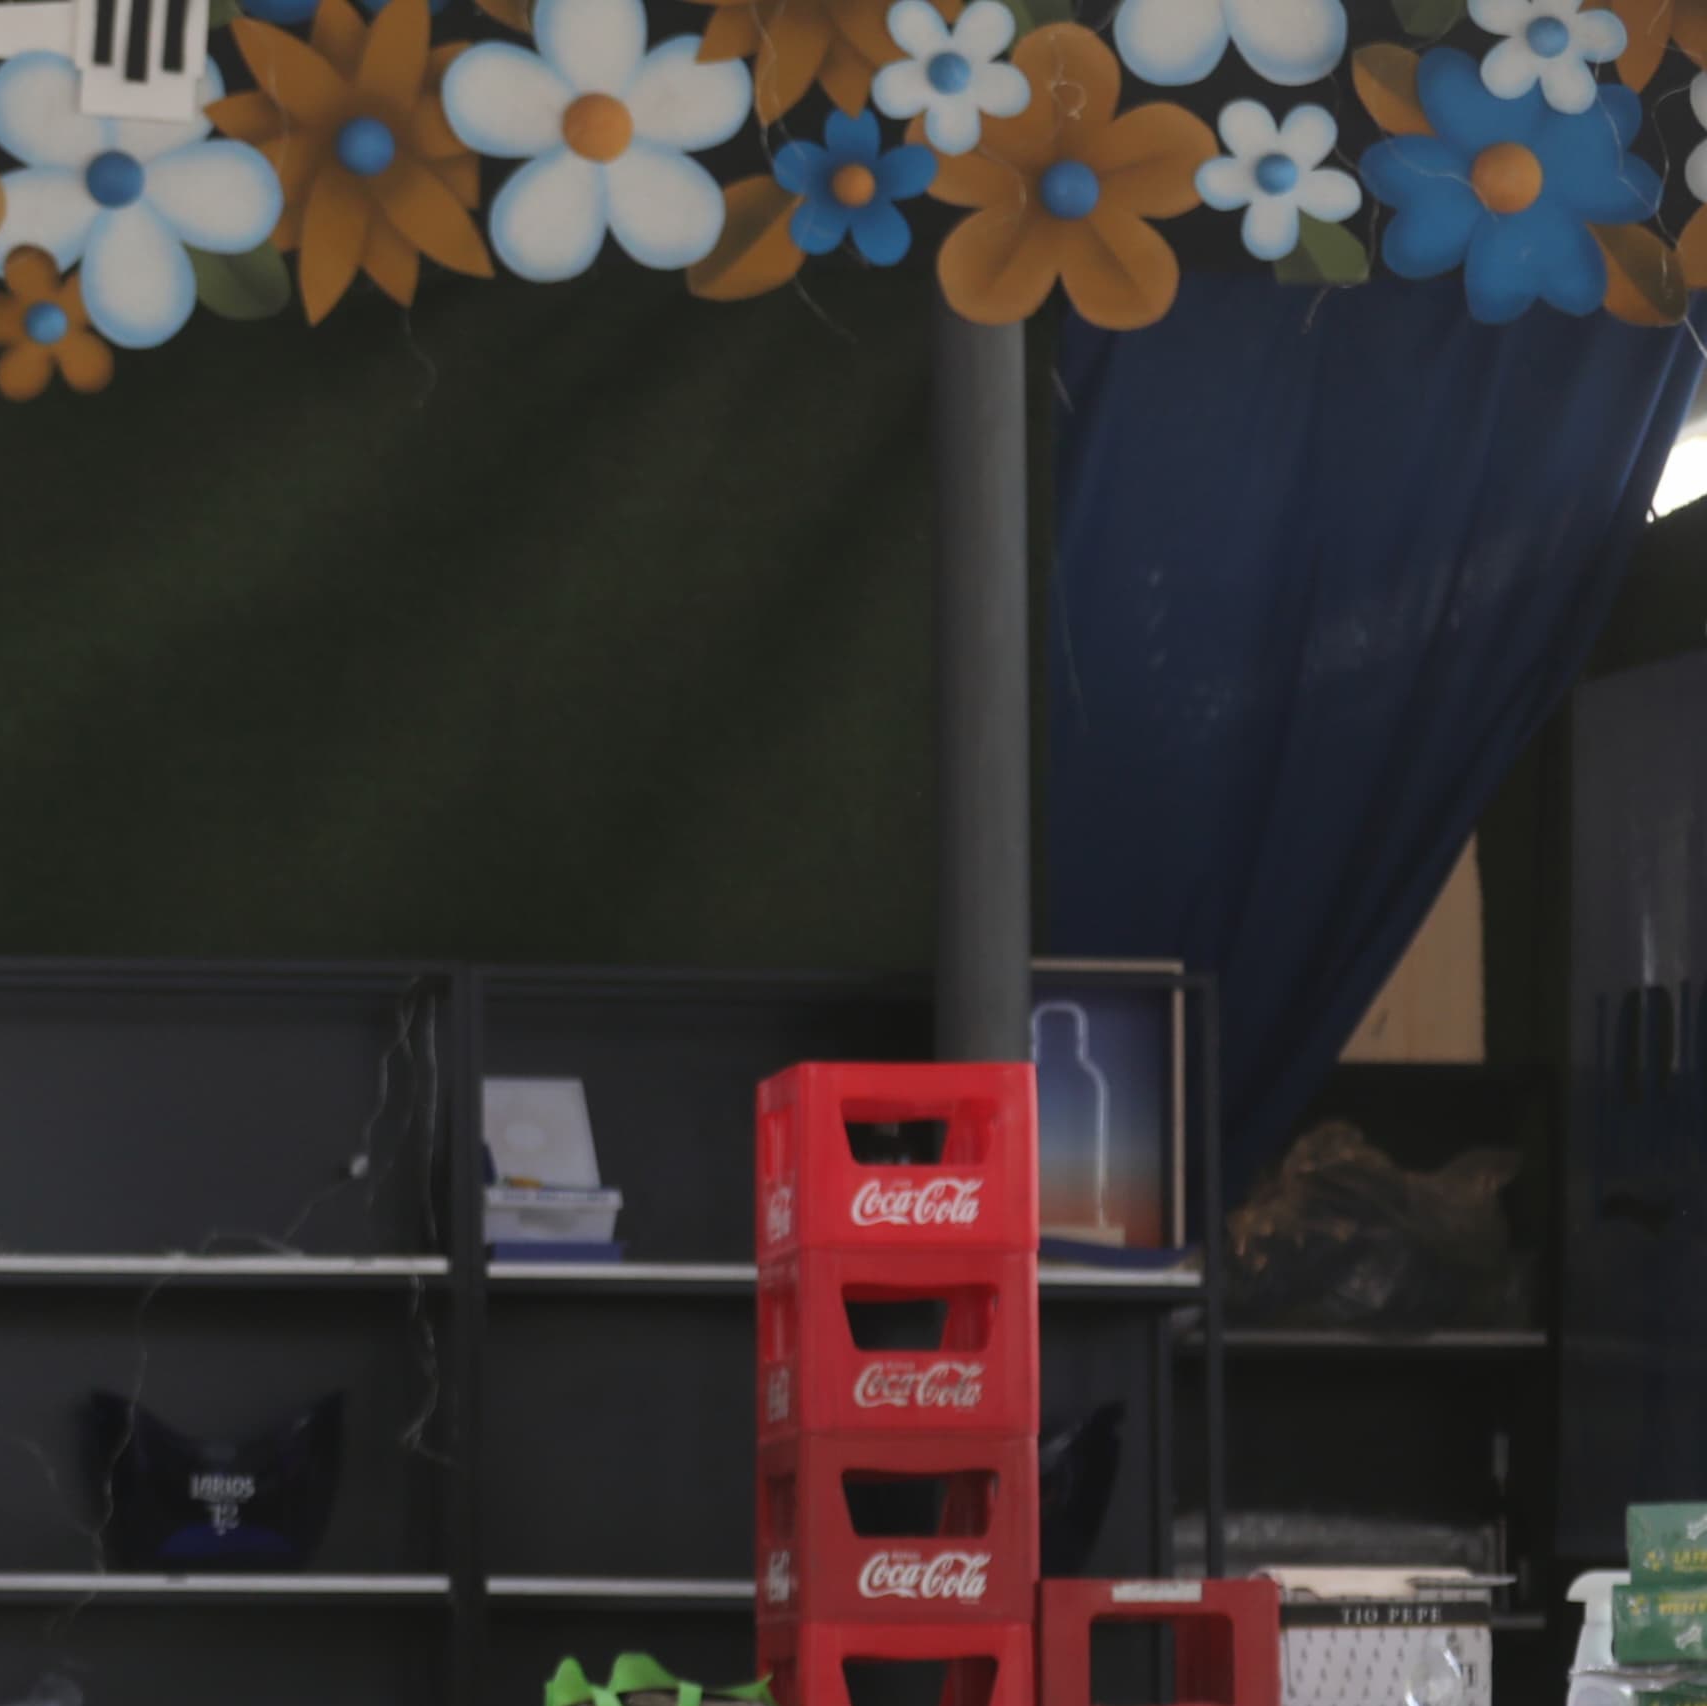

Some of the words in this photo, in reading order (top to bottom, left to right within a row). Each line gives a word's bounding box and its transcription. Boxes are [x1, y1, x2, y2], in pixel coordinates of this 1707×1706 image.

[851, 1177, 984, 1226] Coca-Cola
[853, 1361, 984, 1408] Coca-Cola
[858, 1551, 991, 1598] Coca-Cola
[1341, 1607, 1378, 1624] TIO
[1389, 1607, 1443, 1624] PEPE
